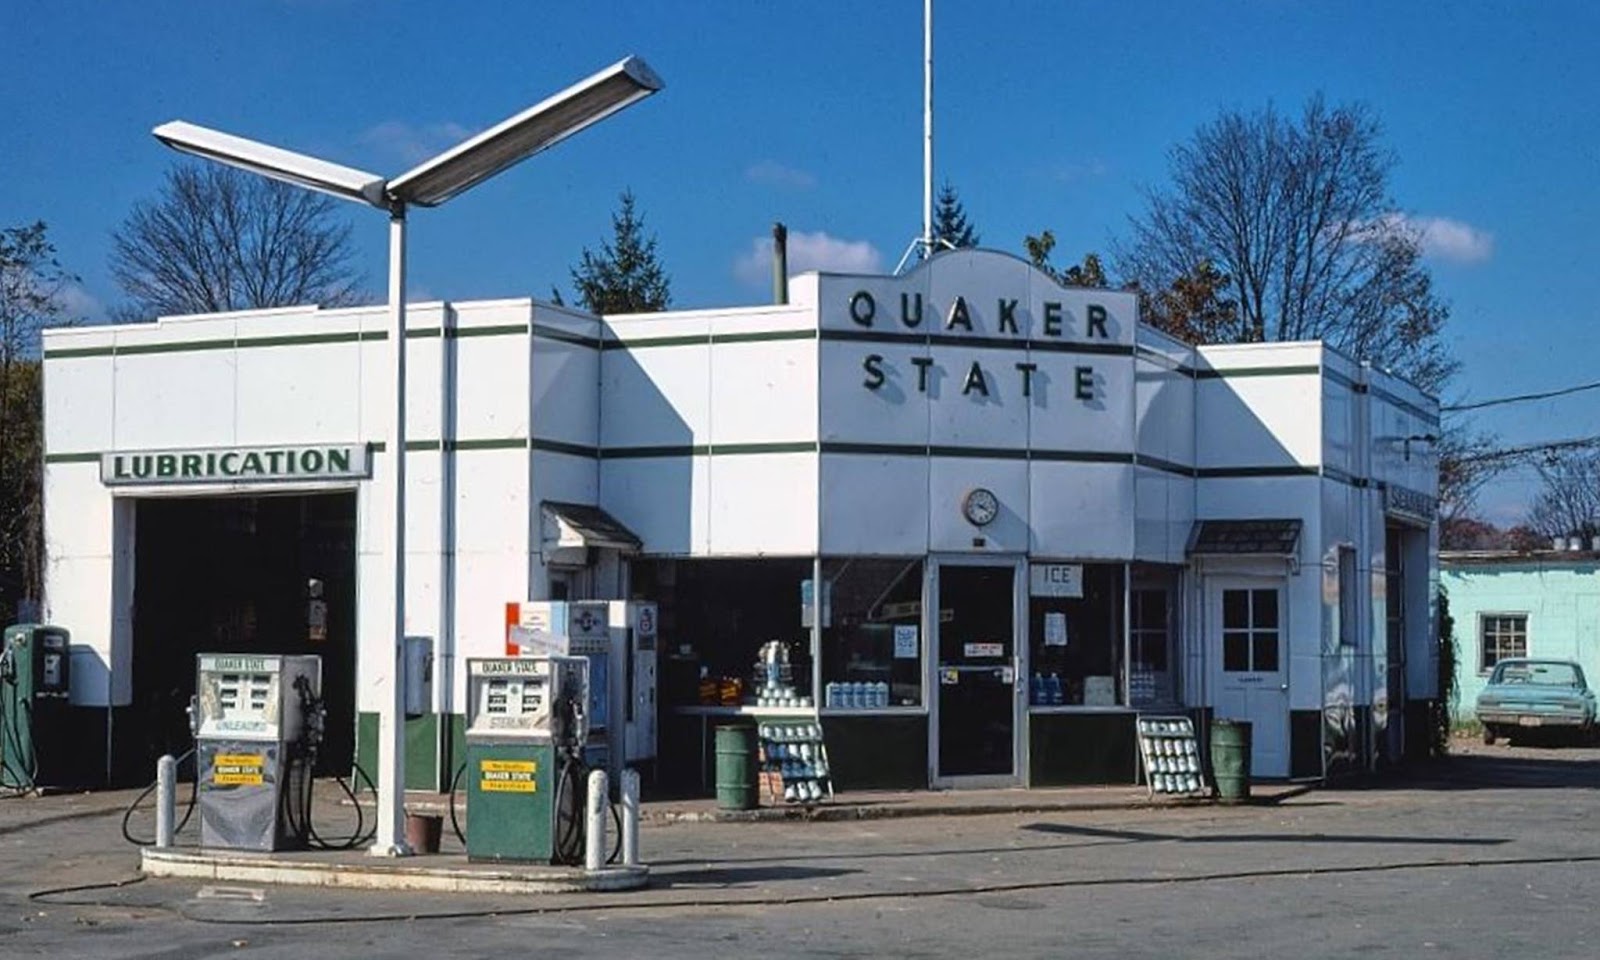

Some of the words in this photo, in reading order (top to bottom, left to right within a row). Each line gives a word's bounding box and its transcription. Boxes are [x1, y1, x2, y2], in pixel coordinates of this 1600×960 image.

[850, 291, 1109, 338] QUAKER
[862, 354, 1094, 400] STATE
[114, 450, 350, 479] LUBRICATION
[1044, 566, 1071, 583] ICE
[215, 658, 242, 669] QUAKER
[482, 661, 512, 673] QUAKER
[514, 661, 539, 673] STATE
[484, 771, 510, 780] QUAKER
